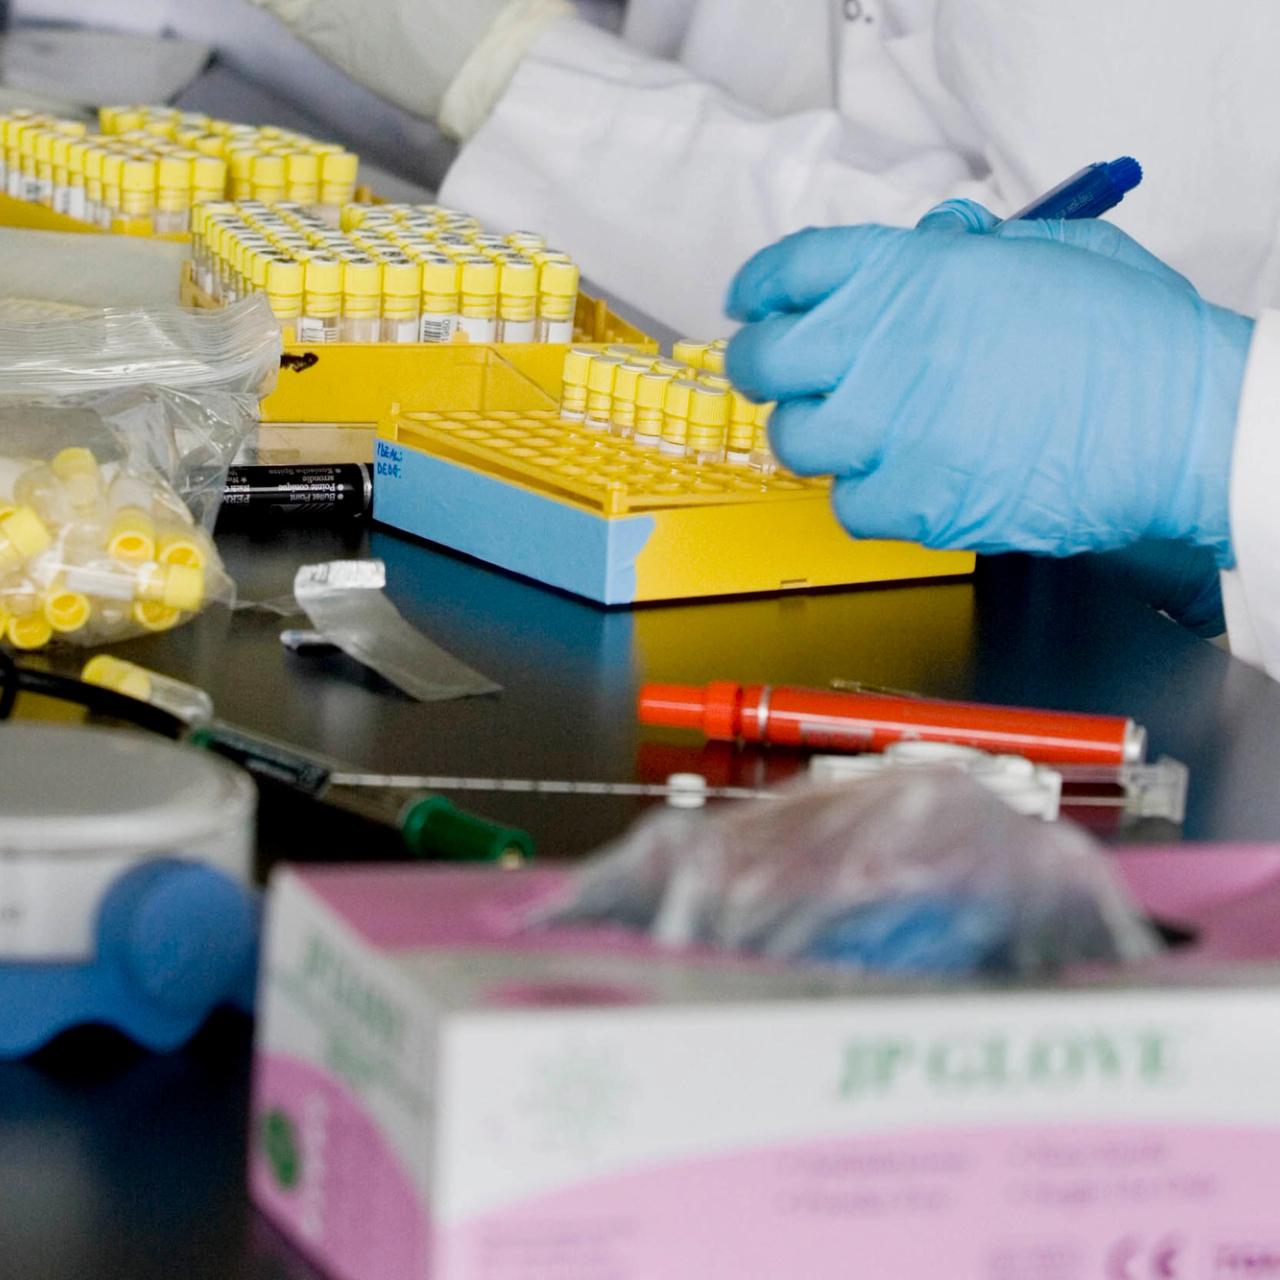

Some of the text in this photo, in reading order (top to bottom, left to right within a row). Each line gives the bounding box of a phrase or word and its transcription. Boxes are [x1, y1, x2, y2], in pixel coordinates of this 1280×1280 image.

[302, 475, 335, 483] arrondie
[278, 482, 336, 492] Pointe conique
[289, 493, 336, 502] Bullet Point
[924, 1029, 1183, 1091] GLOVE
